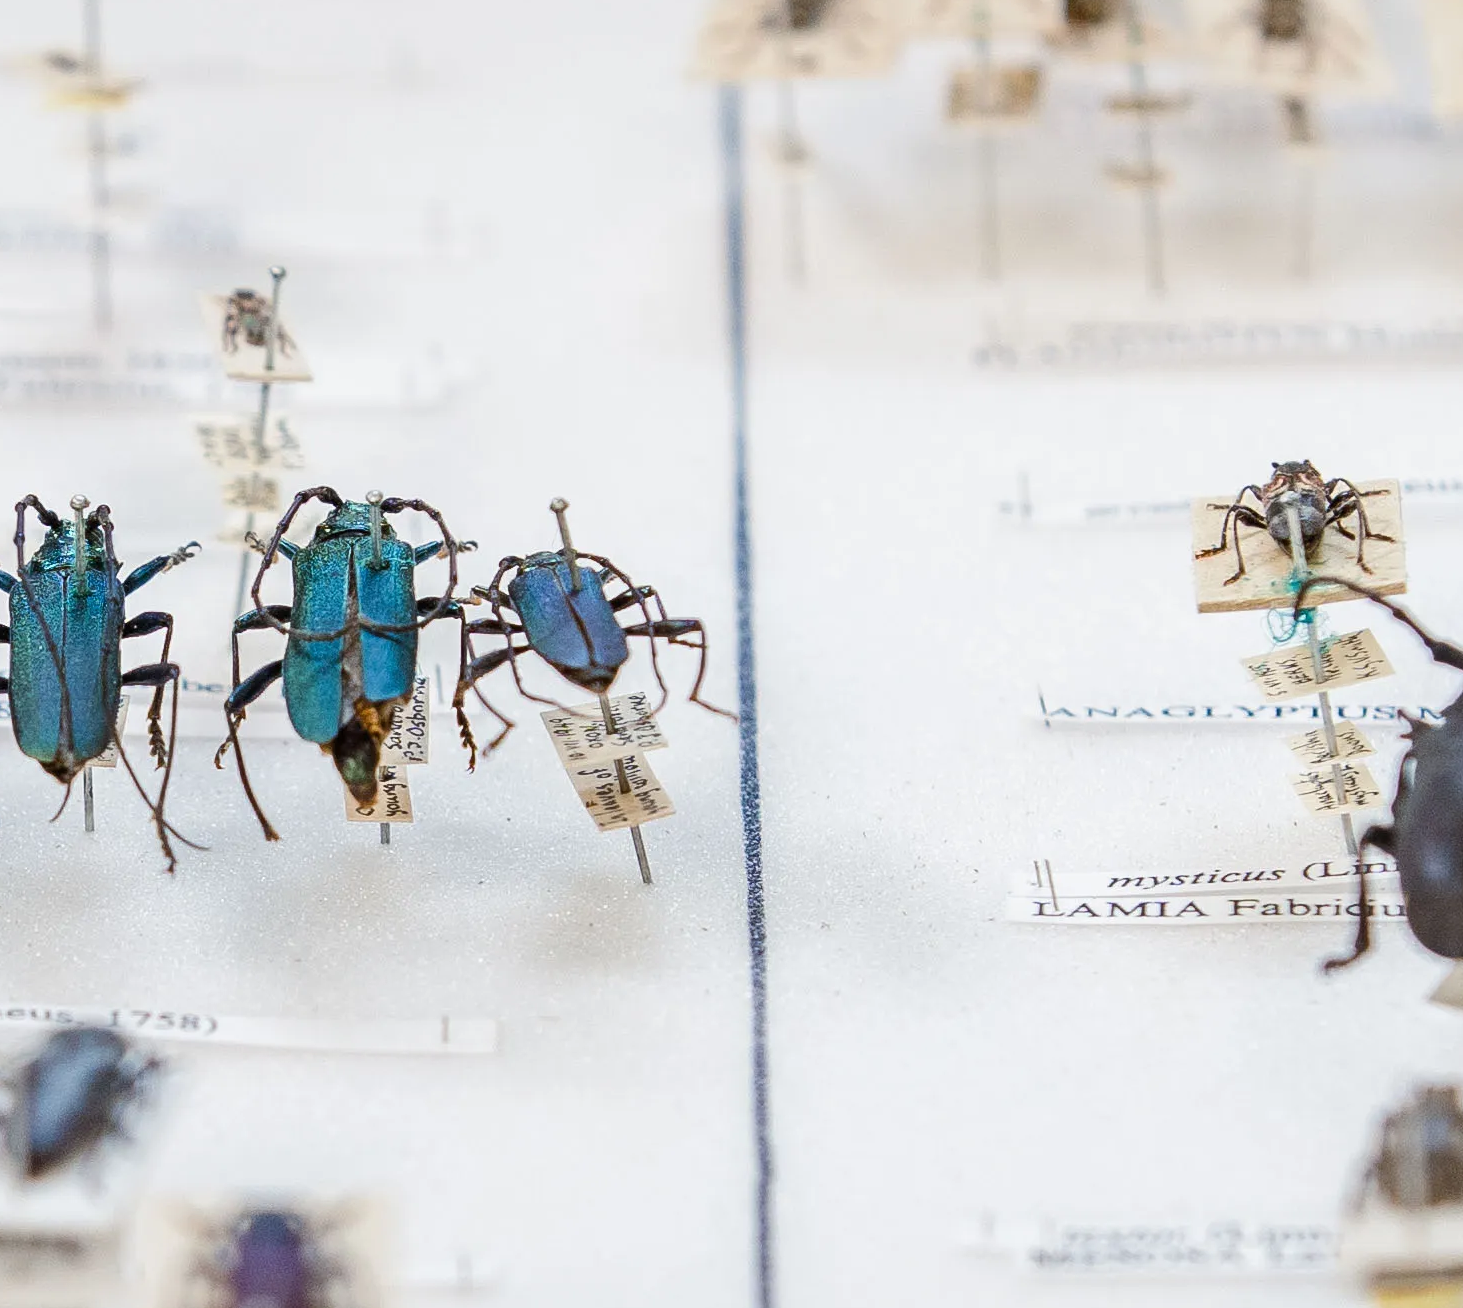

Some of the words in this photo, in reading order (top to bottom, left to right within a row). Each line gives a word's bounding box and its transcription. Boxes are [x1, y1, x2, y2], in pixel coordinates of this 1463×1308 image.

[1041, 704, 1399, 722] ANAGLYPTUS
[382, 783, 409, 817] young
[1106, 865, 1287, 889] mysticus
[1032, 899, 1209, 918] LAMIA
[1226, 897, 1406, 918] Fabriciu
